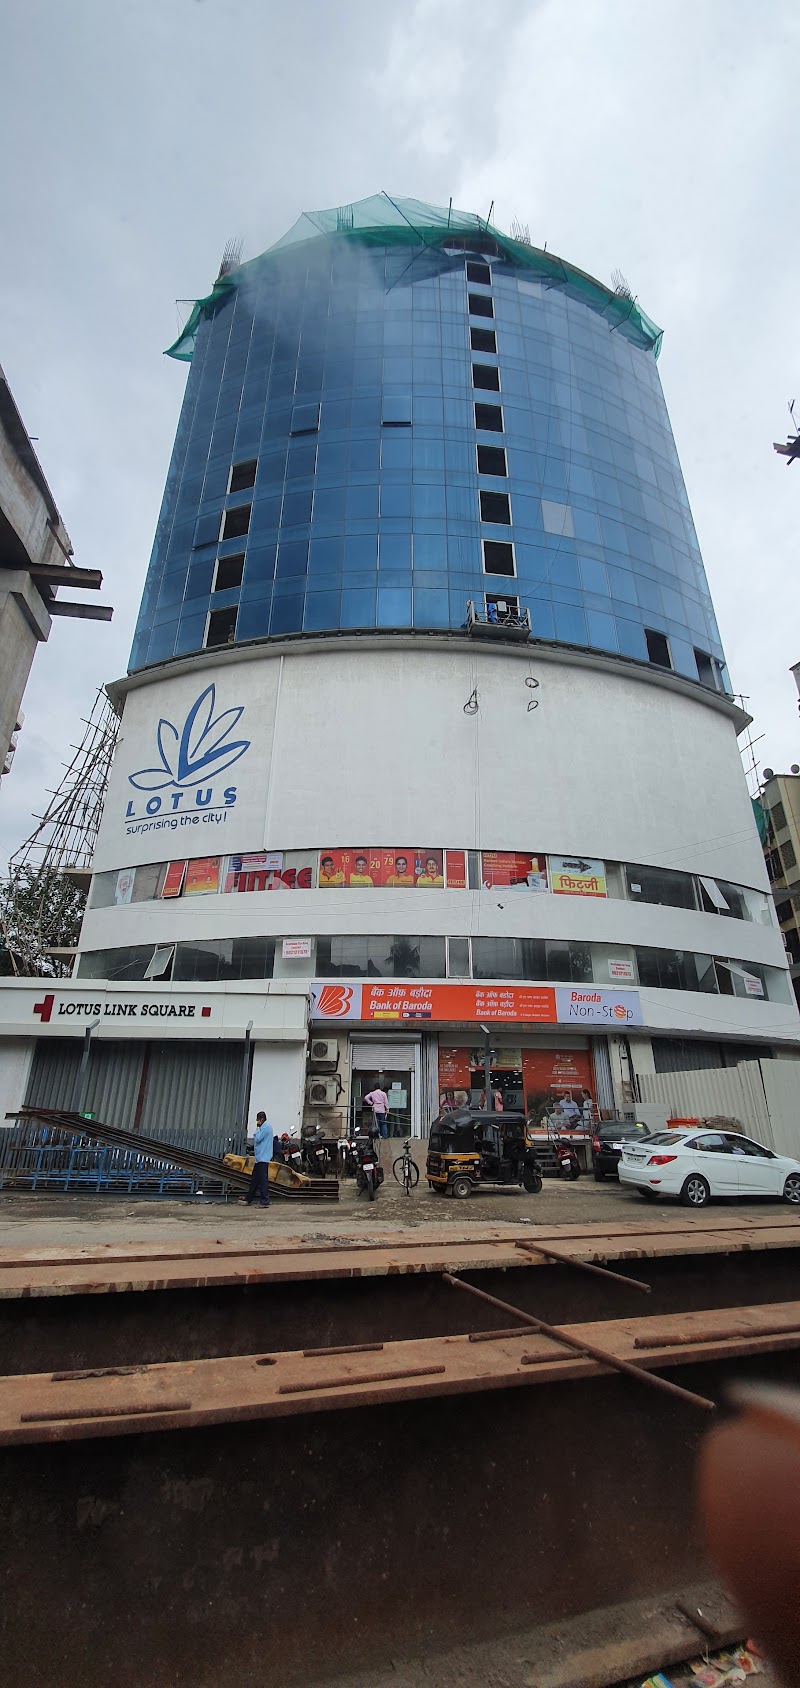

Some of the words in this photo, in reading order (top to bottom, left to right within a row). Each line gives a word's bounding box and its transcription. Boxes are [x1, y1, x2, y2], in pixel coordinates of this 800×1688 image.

[126, 787, 237, 817] LOTUS
[126, 818, 178, 835] surprising
[180, 815, 200, 826] the
[341, 855, 350, 864] 16
[370, 860, 381, 869] 20
[383, 857, 394, 866] 79
[571, 991, 602, 1003] Baroda
[58, 1003, 101, 1016] LOTUS
[103, 1003, 138, 1016] LINK
[141, 1005, 196, 1017] SQUARE
[370, 1001, 391, 1010] Bank
[392, 1001, 401, 1010] of
[402, 1001, 433, 1011] Baroda
[497, 1009, 517, 1017] Baroda
